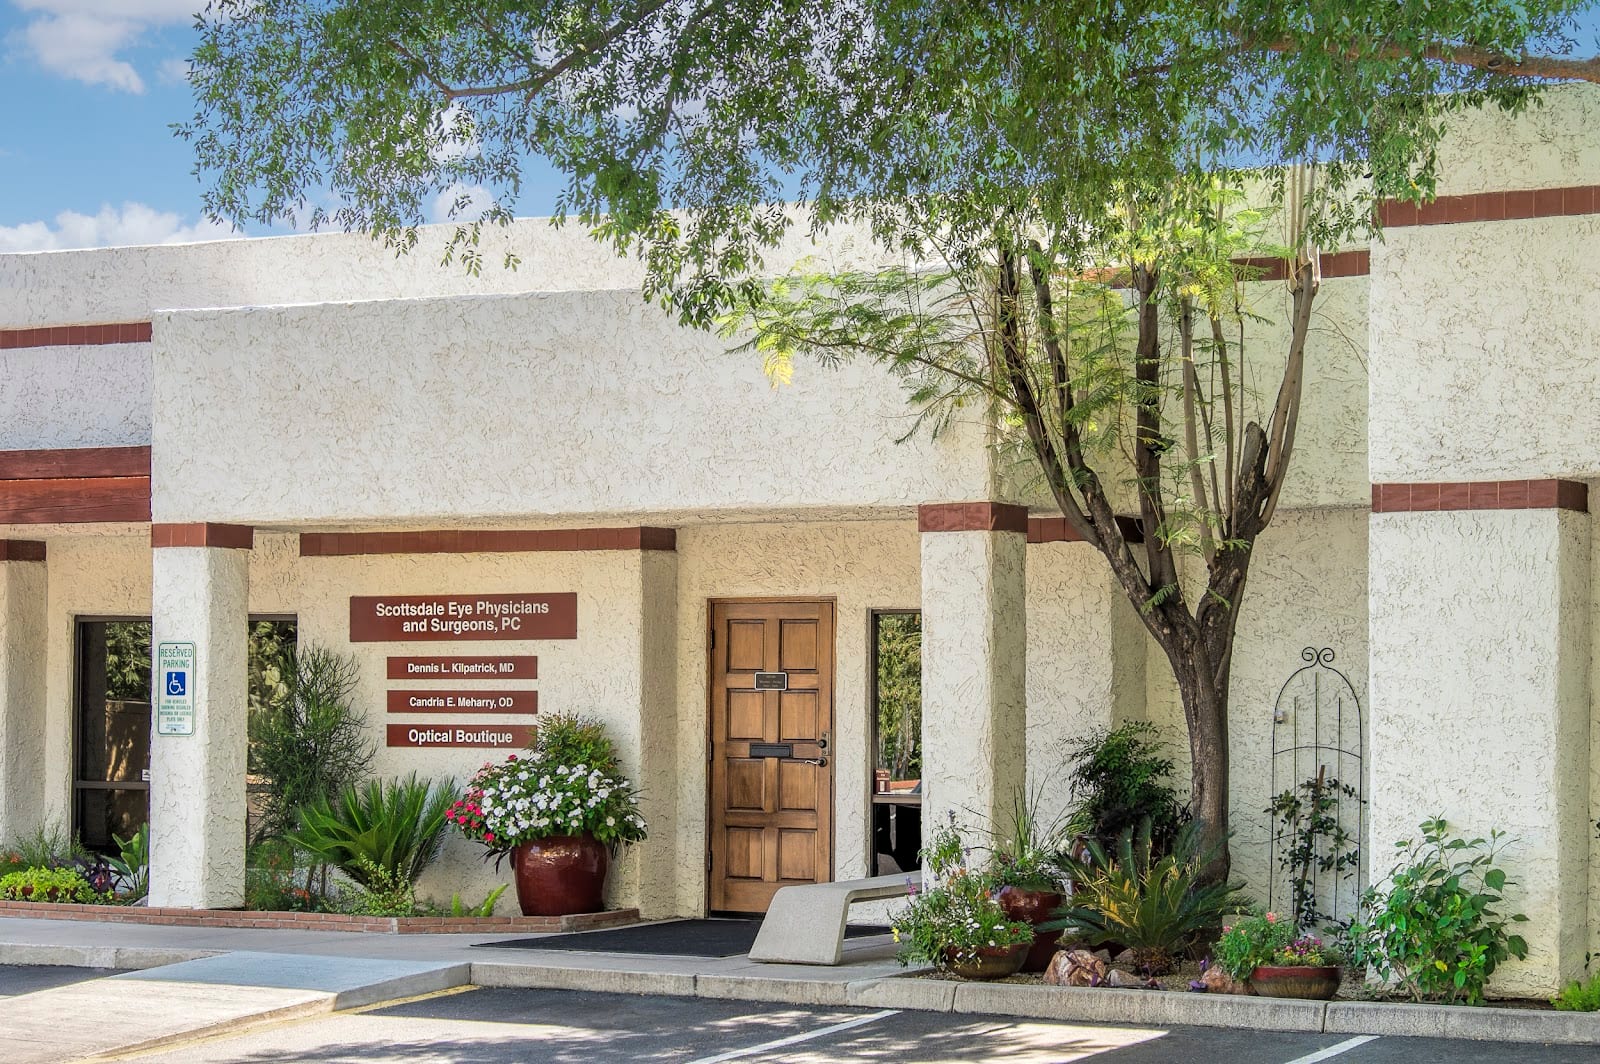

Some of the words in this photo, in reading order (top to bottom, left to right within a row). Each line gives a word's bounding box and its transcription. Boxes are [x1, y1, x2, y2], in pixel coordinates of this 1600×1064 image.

[376, 602, 444, 617] Scottsdale
[448, 601, 473, 618] Eye
[476, 600, 549, 618] Physicians
[402, 618, 427, 632] and
[431, 617, 498, 634] Surgeons,
[501, 616, 521, 631] PC
[160, 648, 193, 658] RESERVED
[163, 659, 190, 669] PARKING
[407, 663, 440, 673] Dennis
[441, 663, 450, 673] L.
[451, 662, 497, 675] Kilpatrick,
[499, 662, 515, 673] MD
[409, 696, 445, 707] Candria
[446, 697, 456, 707] E.
[457, 697, 497, 710] Meharry,
[498, 697, 513, 707] OD
[408, 729, 452, 745] Optical
[455, 729, 513, 745] Boutique
